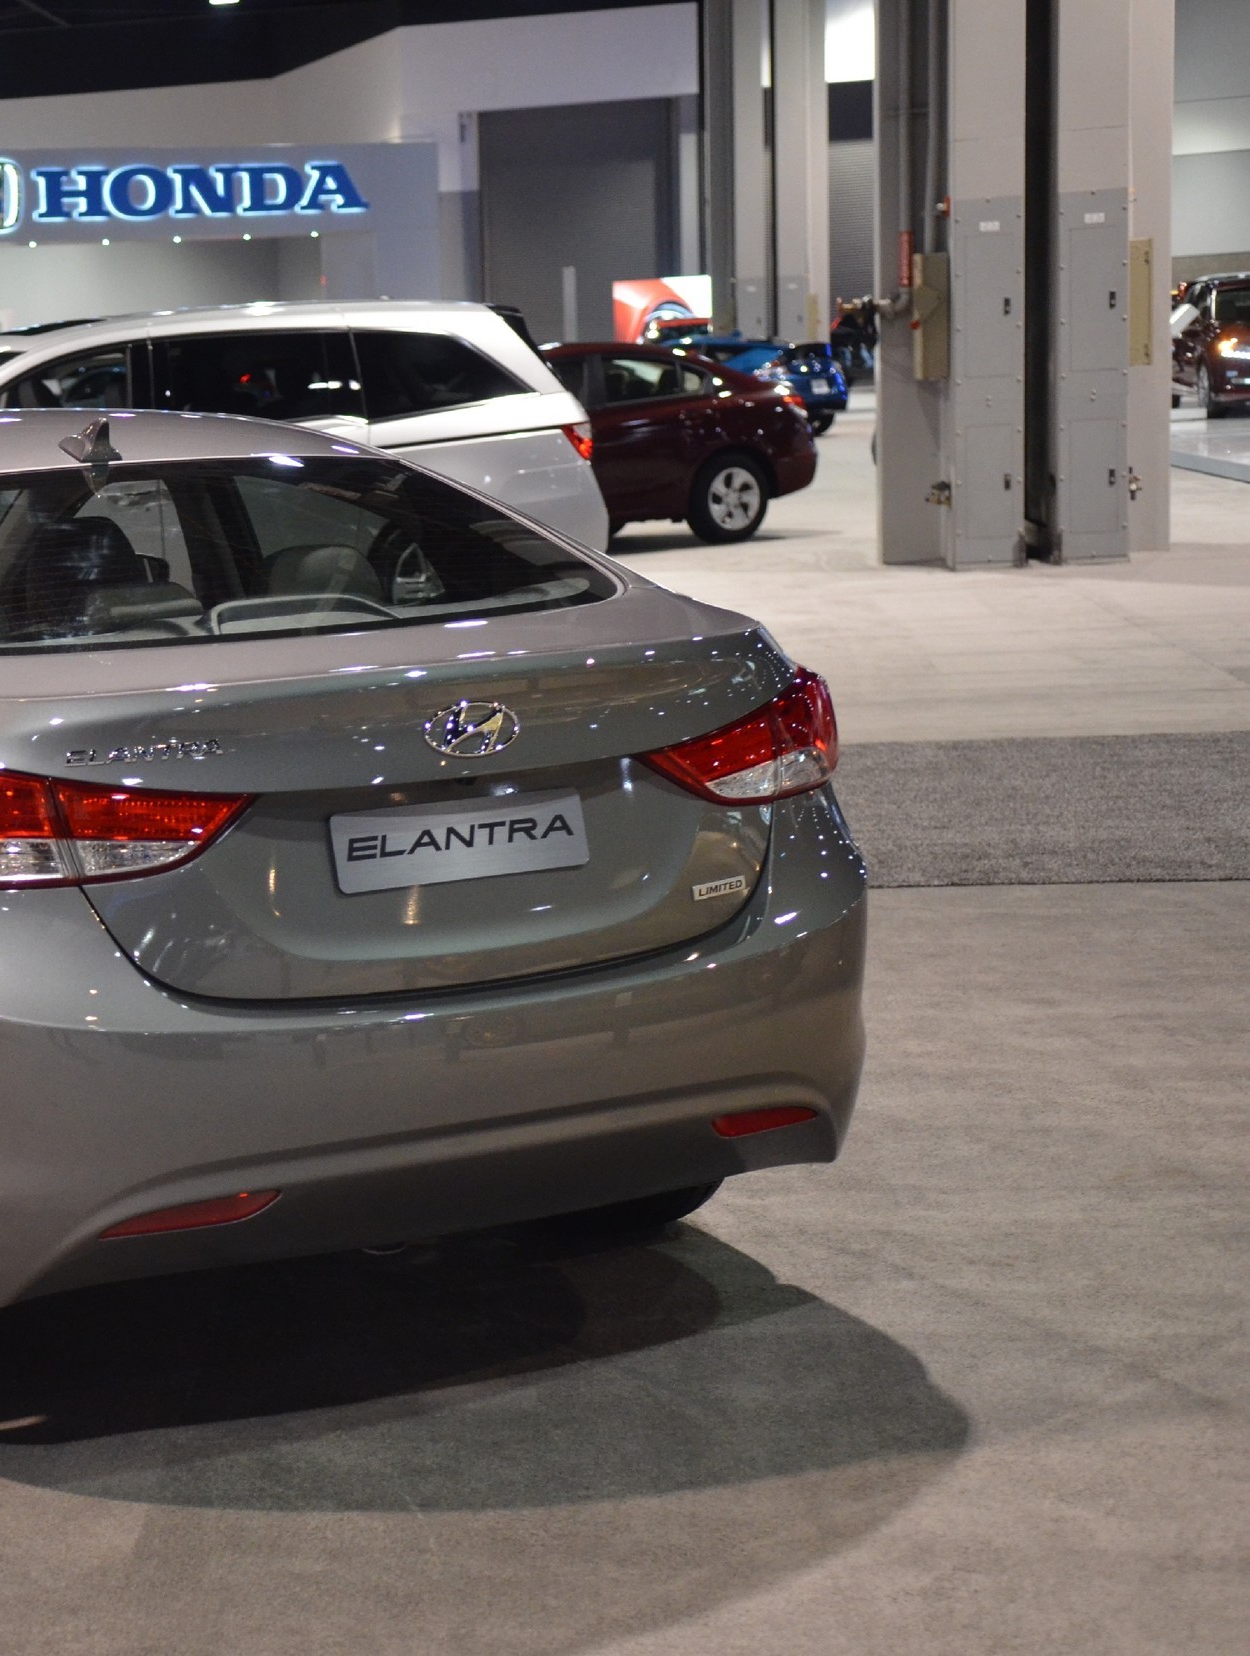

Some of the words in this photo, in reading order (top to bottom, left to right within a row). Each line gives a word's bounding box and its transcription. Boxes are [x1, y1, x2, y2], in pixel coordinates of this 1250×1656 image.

[32, 161, 370, 221] HONDA
[64, 739, 224, 768] ELANTRA
[347, 814, 574, 862] ELANTRA
[698, 879, 743, 897] LIMITED
